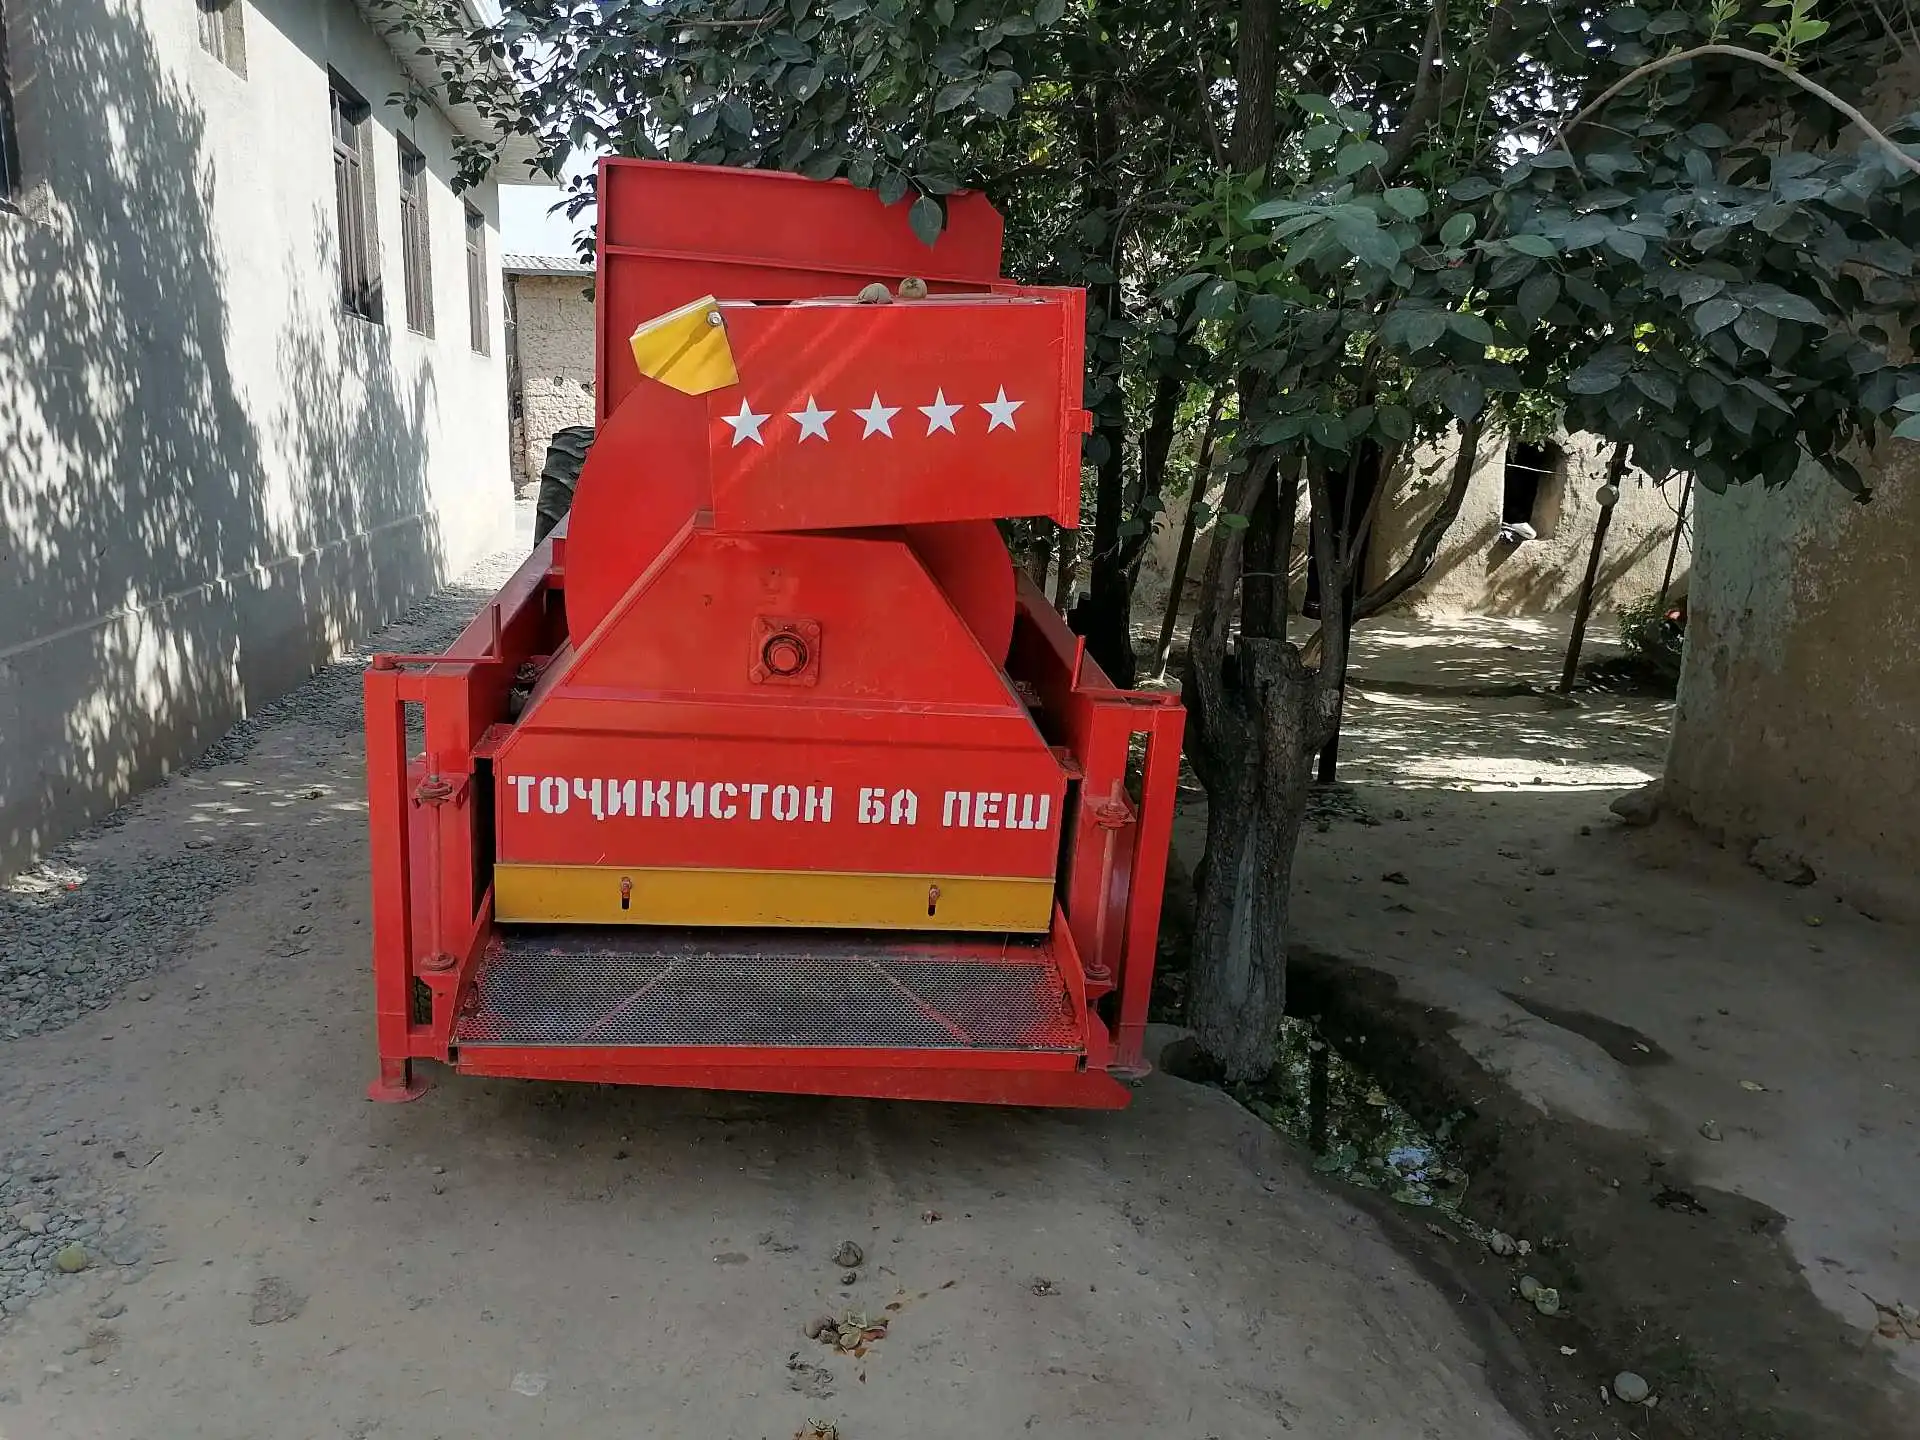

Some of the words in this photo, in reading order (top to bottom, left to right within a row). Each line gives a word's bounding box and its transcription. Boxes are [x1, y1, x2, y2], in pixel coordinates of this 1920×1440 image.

[507, 775, 833, 823] ТОҶИКИСТОН
[858, 787, 918, 825] БА
[942, 790, 1050, 830] ПЕШ
